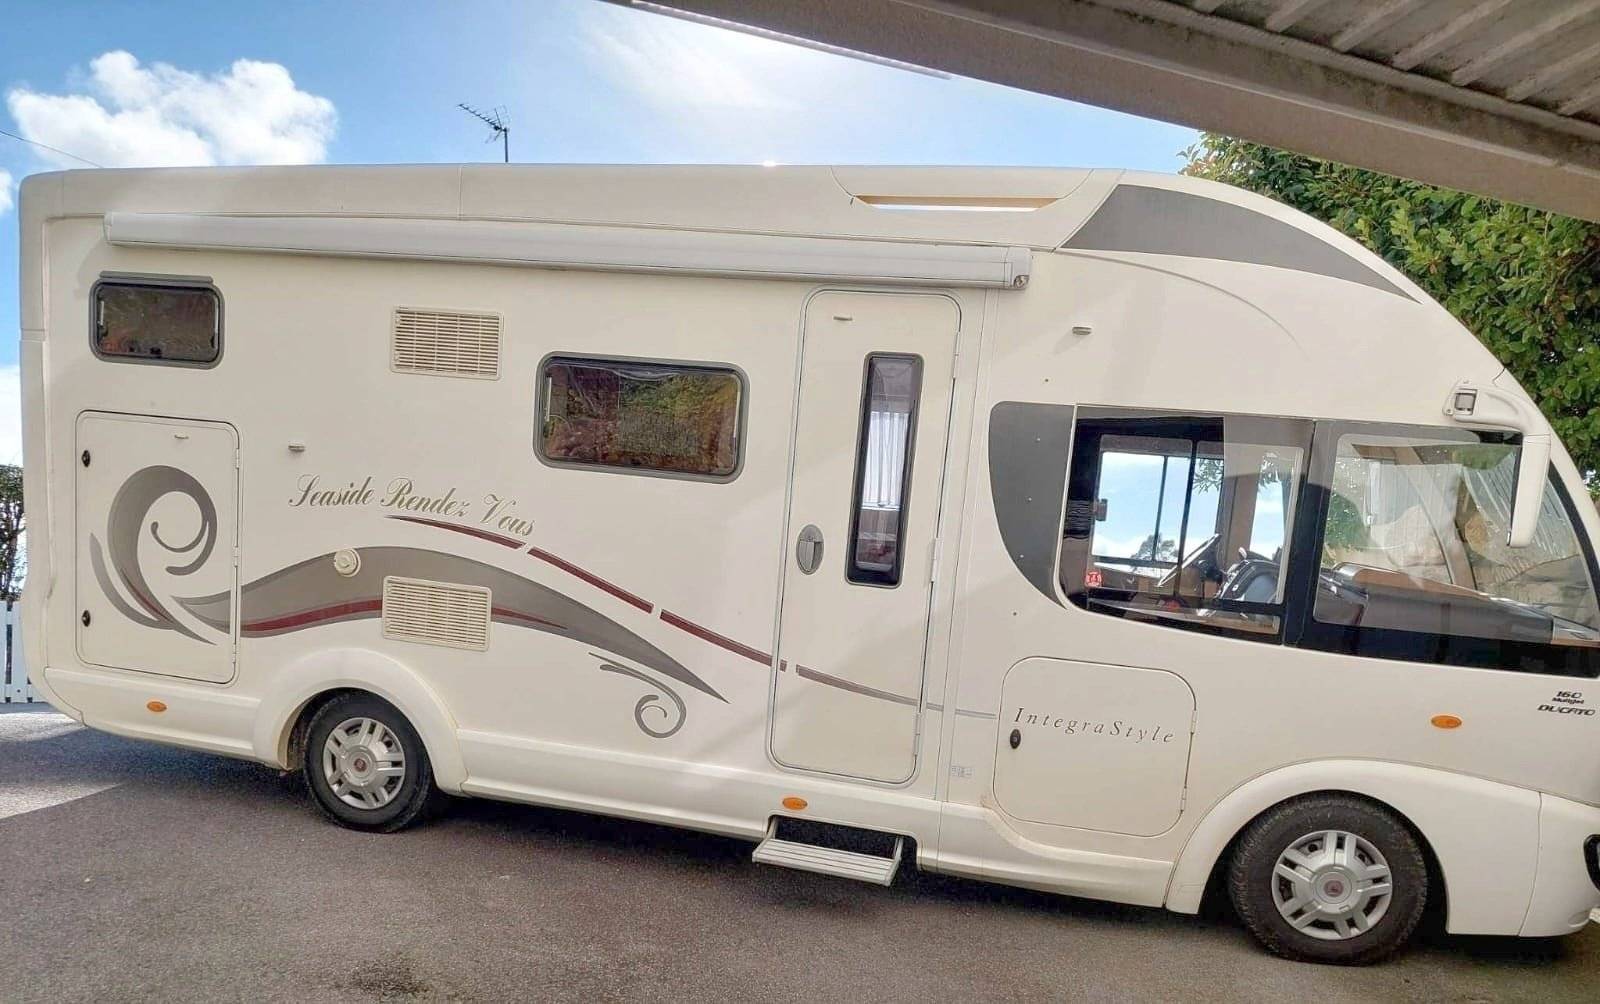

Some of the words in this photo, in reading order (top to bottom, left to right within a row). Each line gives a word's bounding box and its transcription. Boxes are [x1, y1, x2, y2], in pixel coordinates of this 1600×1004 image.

[288, 474, 375, 507] Seaside
[380, 477, 470, 517] Rendez
[480, 493, 536, 537] Vous
[1556, 691, 1583, 699] 160
[1537, 704, 1596, 716] DUCATO
[1014, 707, 1176, 744] IntegraStyle
